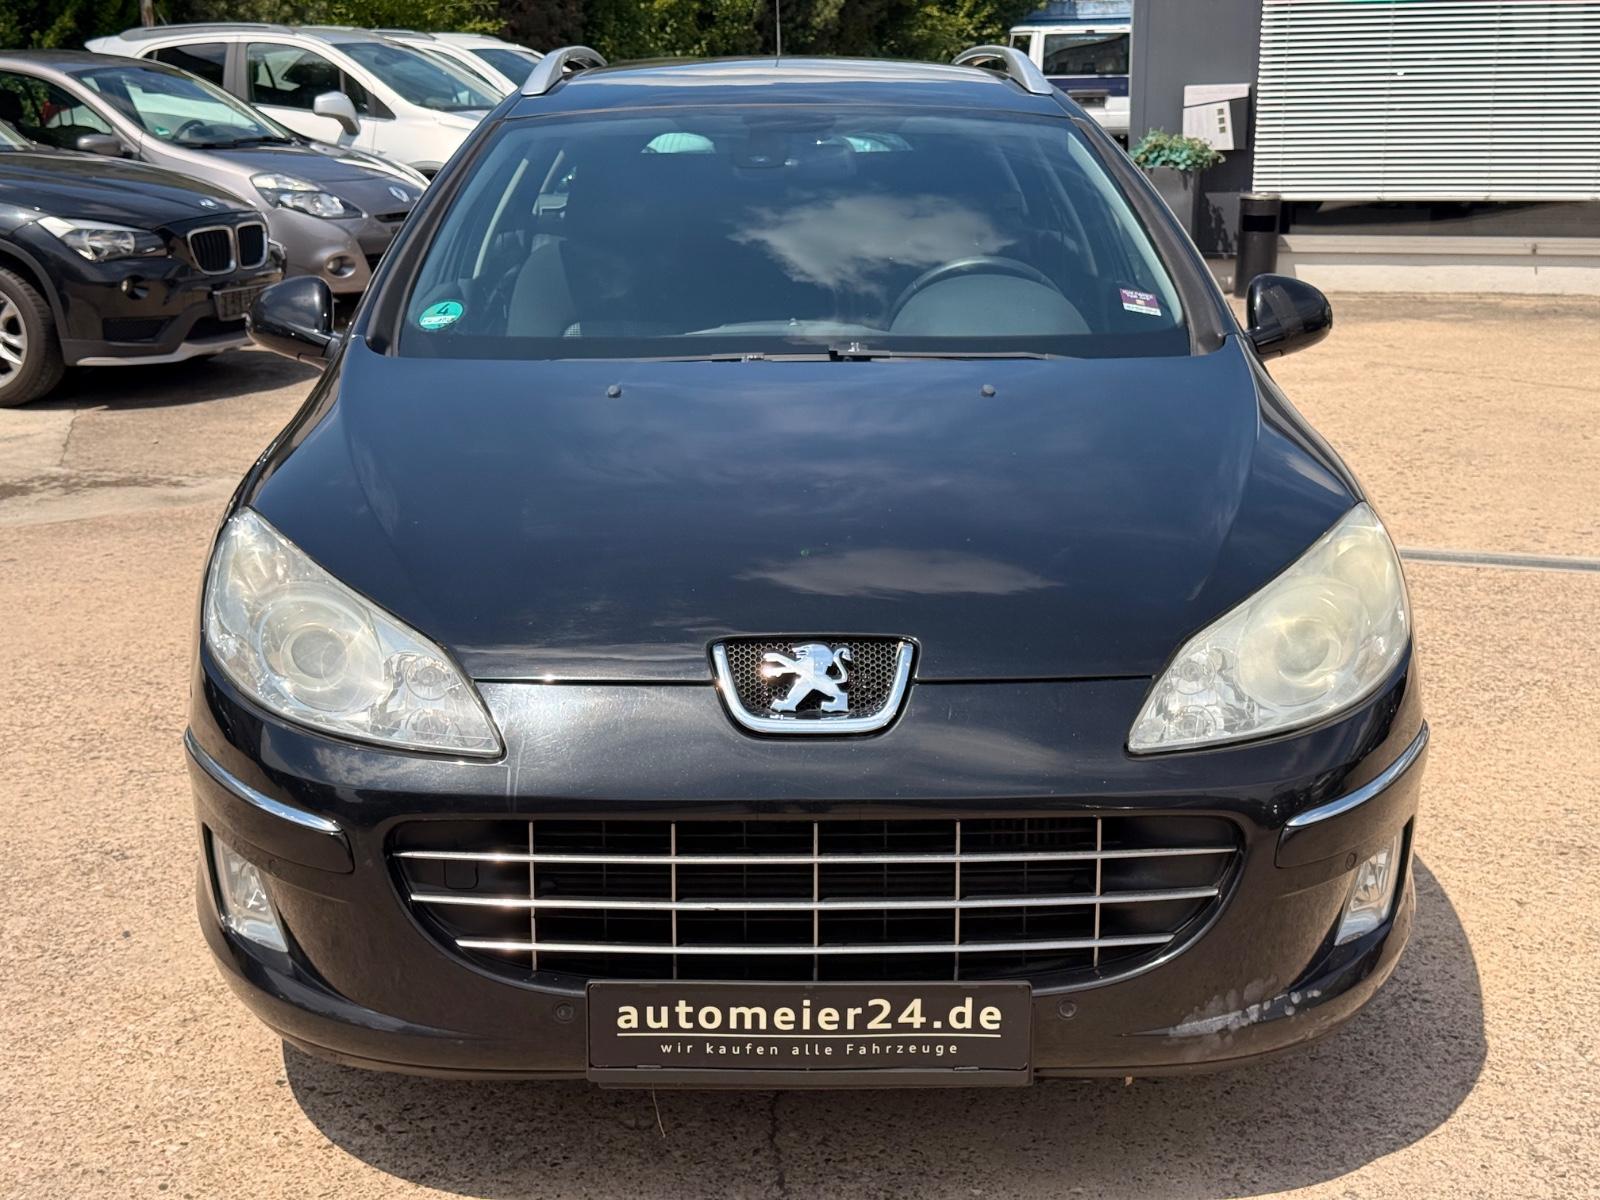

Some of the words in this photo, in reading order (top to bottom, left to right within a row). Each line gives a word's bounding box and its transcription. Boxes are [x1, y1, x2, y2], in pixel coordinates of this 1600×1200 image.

[436, 302, 450, 315] 4
[616, 996, 1002, 1031] automeier24.de
[660, 1043, 693, 1054] wir
[706, 1042, 778, 1055] kaufen
[791, 1043, 833, 1056] alle
[846, 1042, 959, 1057] Fahrzeuge
